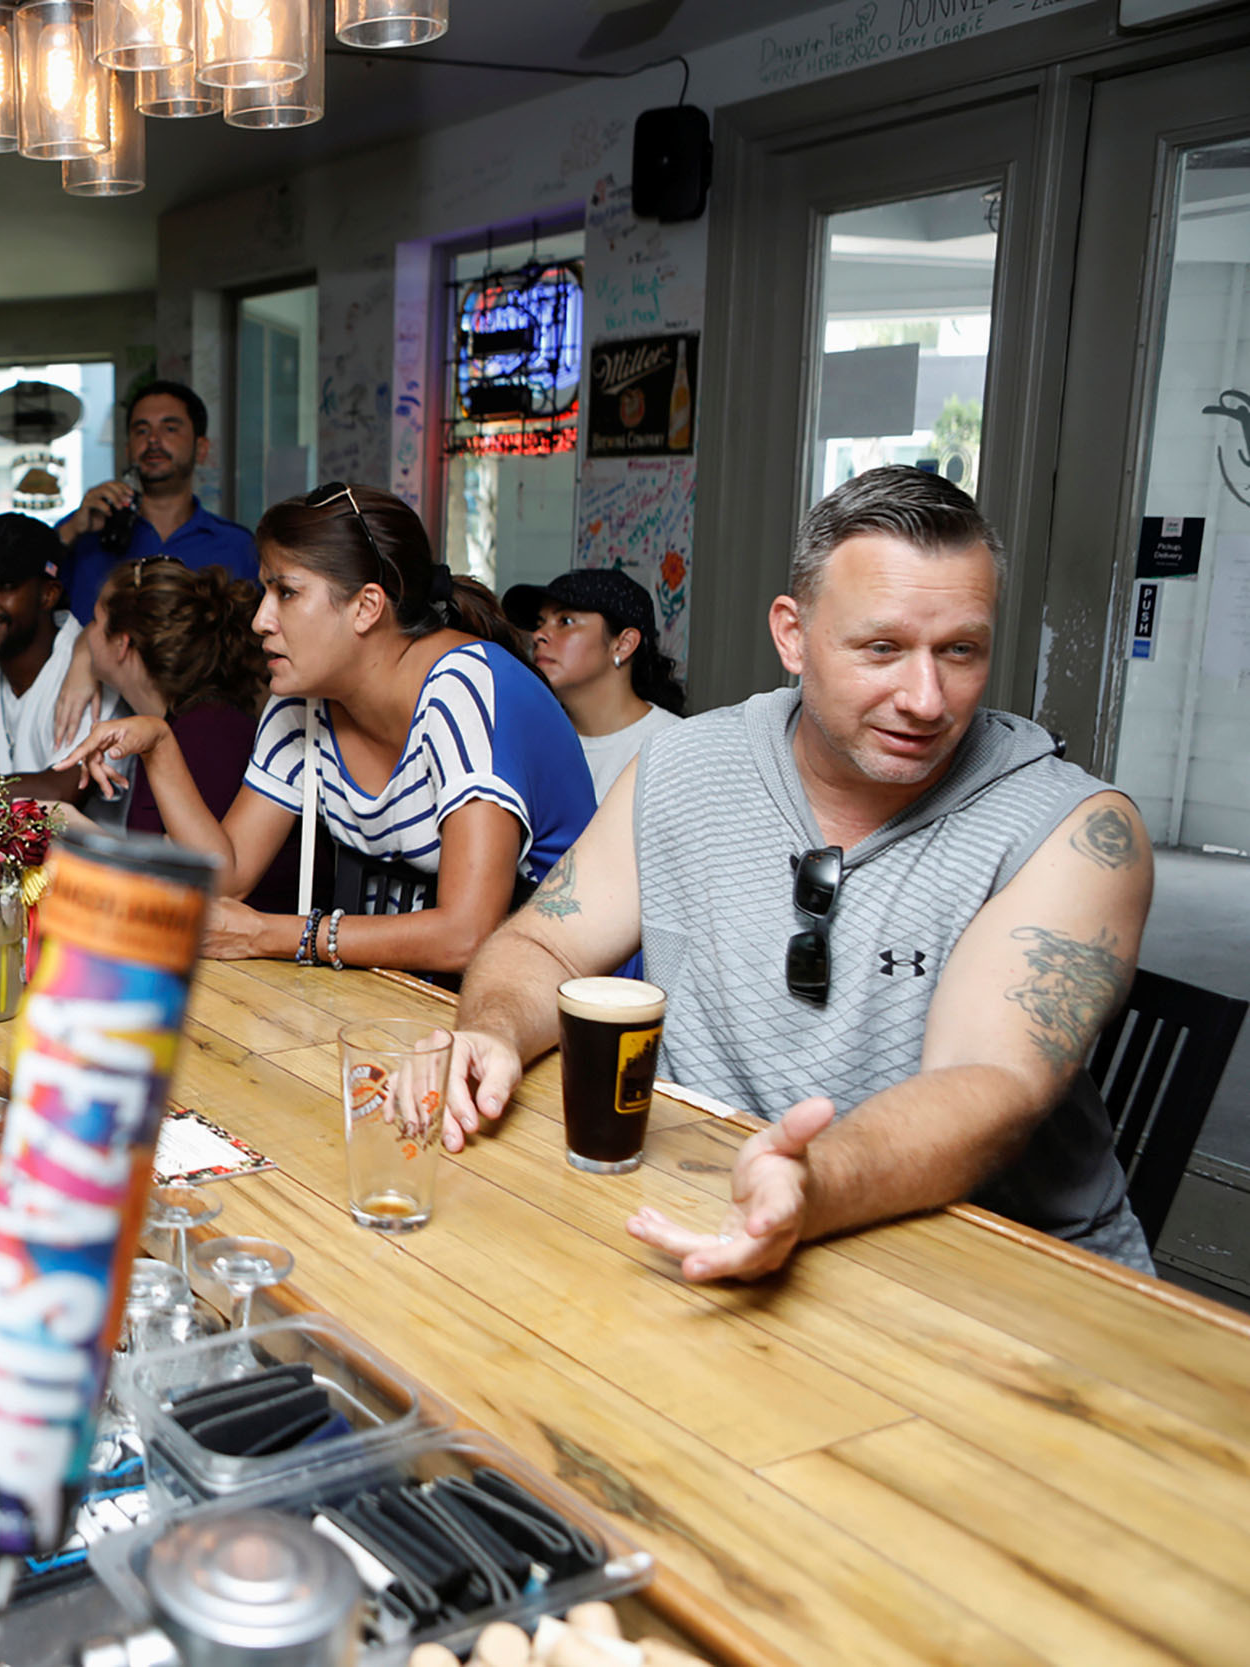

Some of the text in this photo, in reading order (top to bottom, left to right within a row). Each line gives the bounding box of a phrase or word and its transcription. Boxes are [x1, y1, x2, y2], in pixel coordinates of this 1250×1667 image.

[806, 53, 842, 73] HERE
[844, 33, 892, 65] 2020
[592, 342, 671, 395] Miller
[1138, 587, 1153, 634] PUSH
